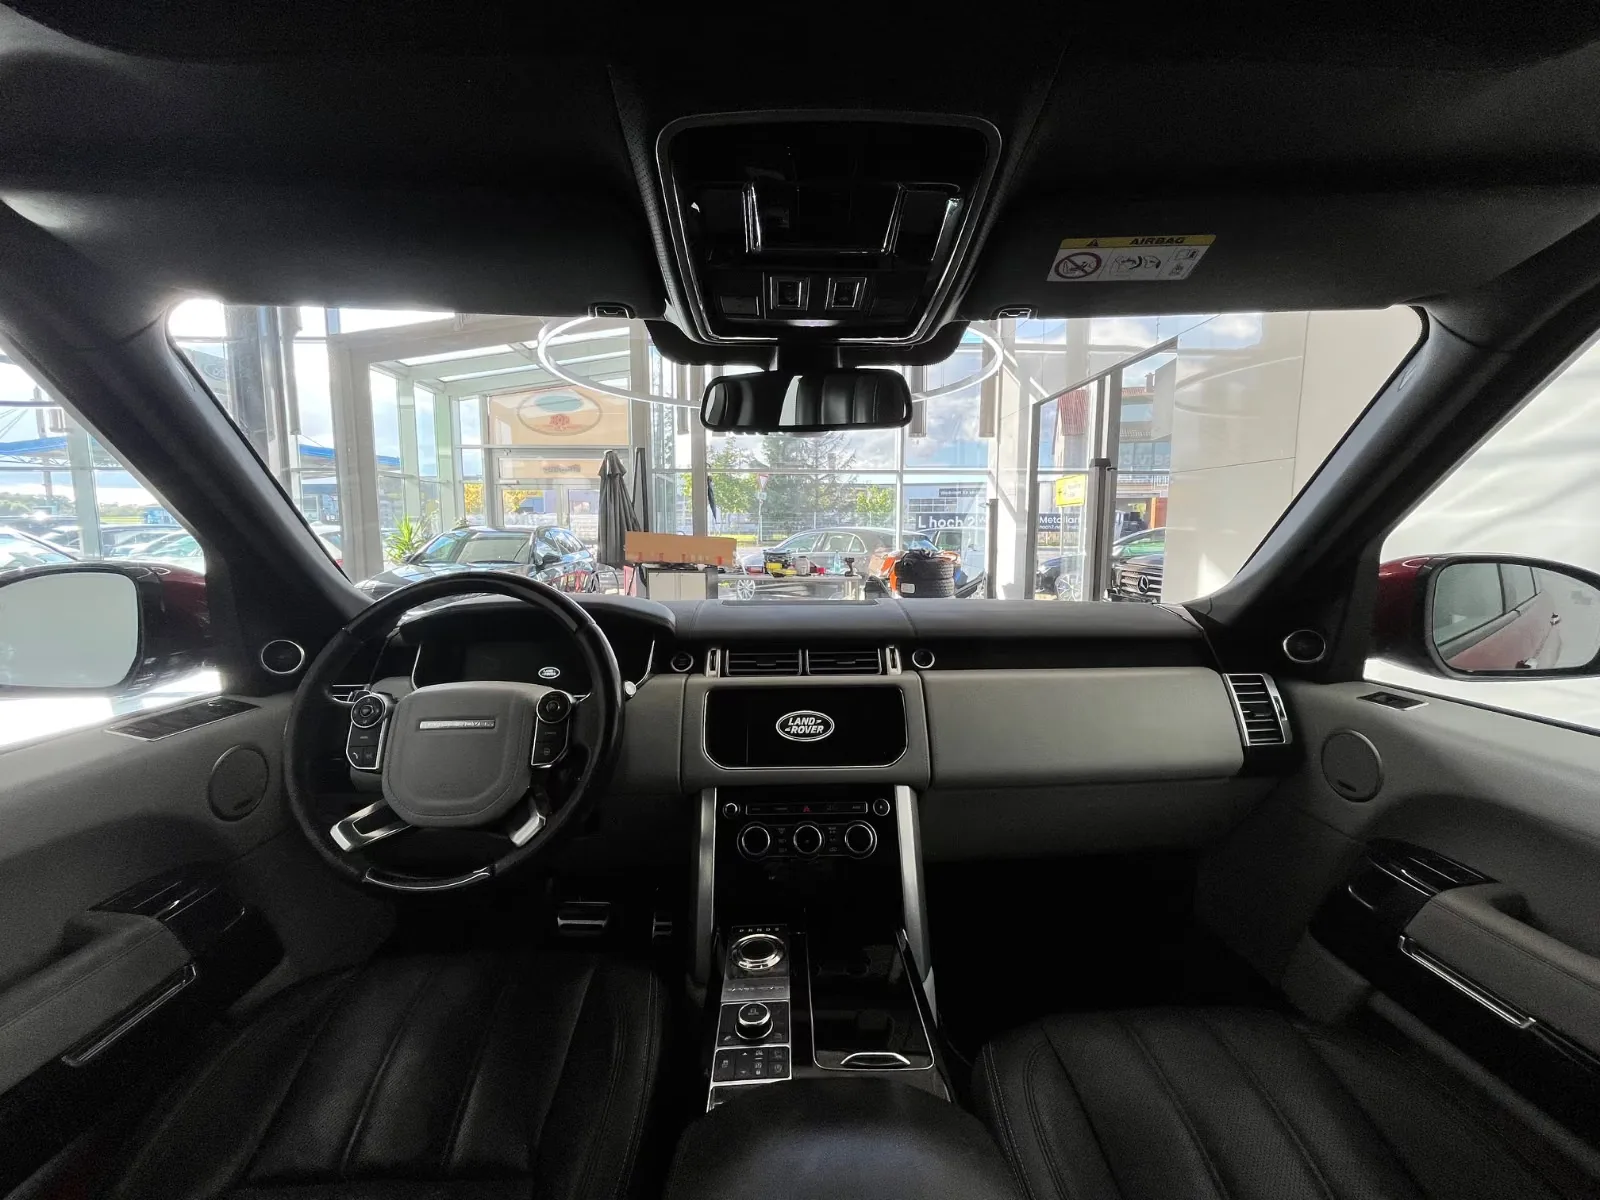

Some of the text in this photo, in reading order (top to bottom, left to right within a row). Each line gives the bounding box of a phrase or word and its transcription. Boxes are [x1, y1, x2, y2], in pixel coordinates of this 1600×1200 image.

[1129, 237, 1185, 245] AIRBAG
[918, 516, 926, 528] L
[929, 516, 963, 528] hoch
[788, 717, 815, 725] LAND
[790, 725, 824, 733] ROVER
